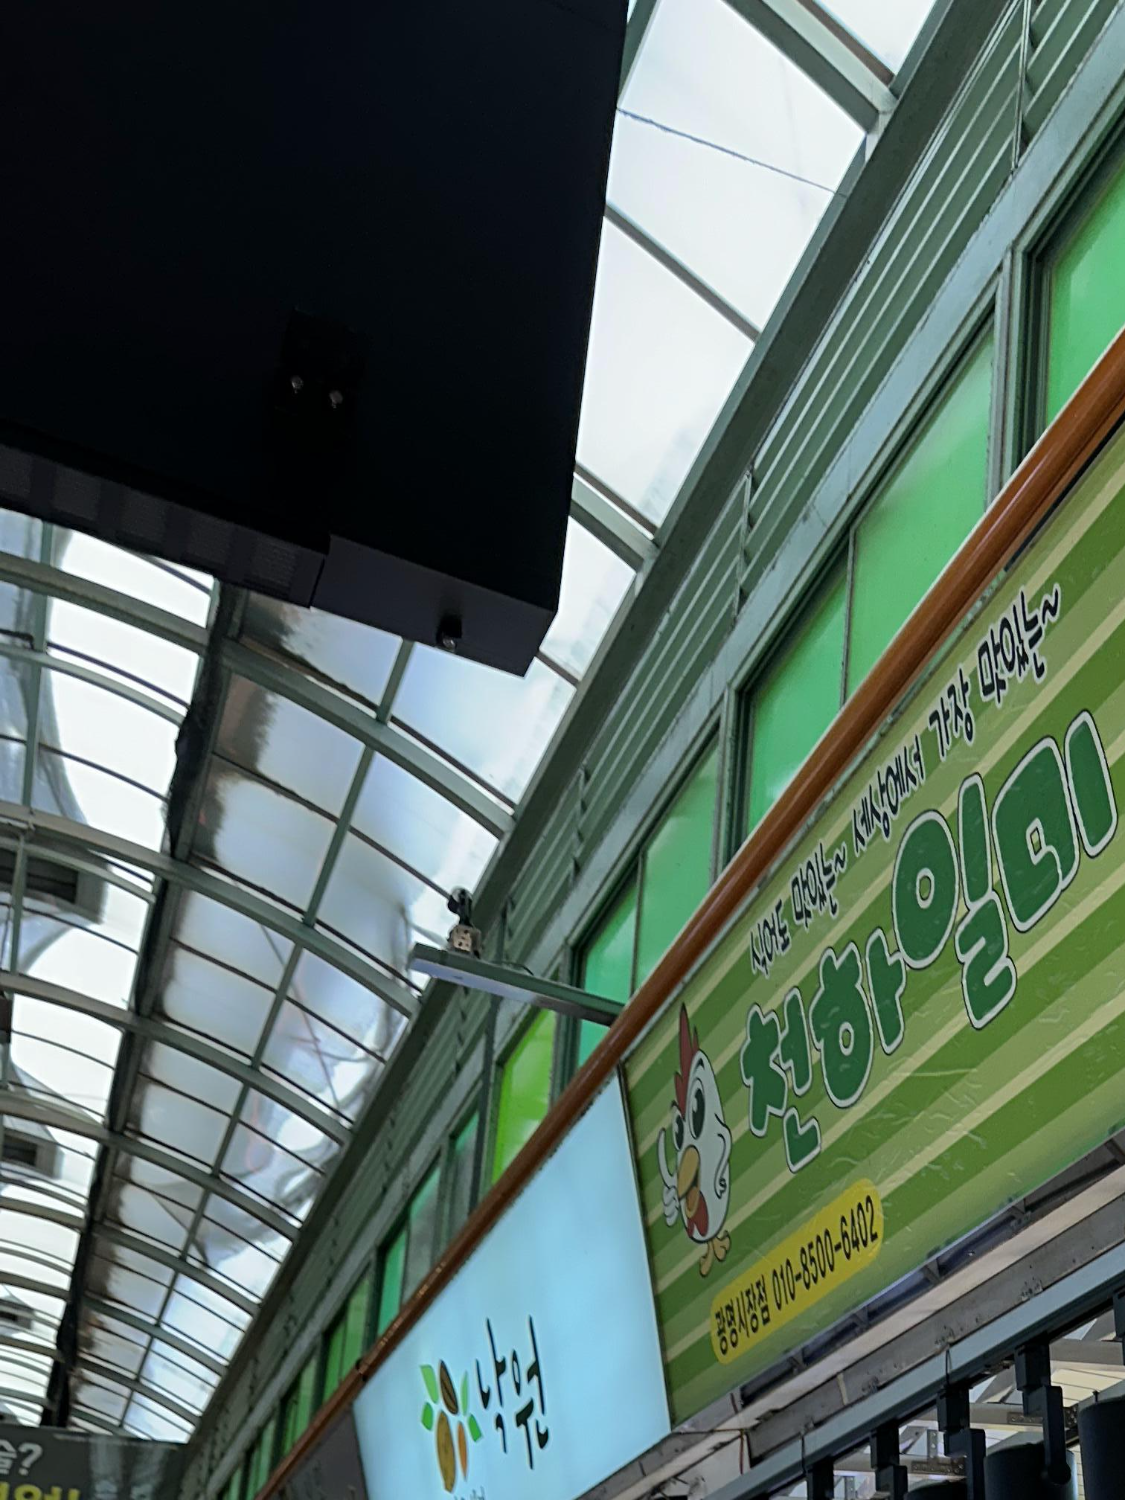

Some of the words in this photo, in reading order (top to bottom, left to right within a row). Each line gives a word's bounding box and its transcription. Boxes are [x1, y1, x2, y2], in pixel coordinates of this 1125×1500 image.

[750, 899, 791, 978] 식어도
[852, 734, 925, 857] 세상에서
[928, 668, 974, 761] 가장
[977, 582, 1060, 703] 맛있는~
[741, 710, 1118, 1174] 천하일미
[475, 1315, 549, 1470] 낙원
[715, 1274, 771, 1356] 광명시장점
[772, 1195, 878, 1311] 010-8500-6402
